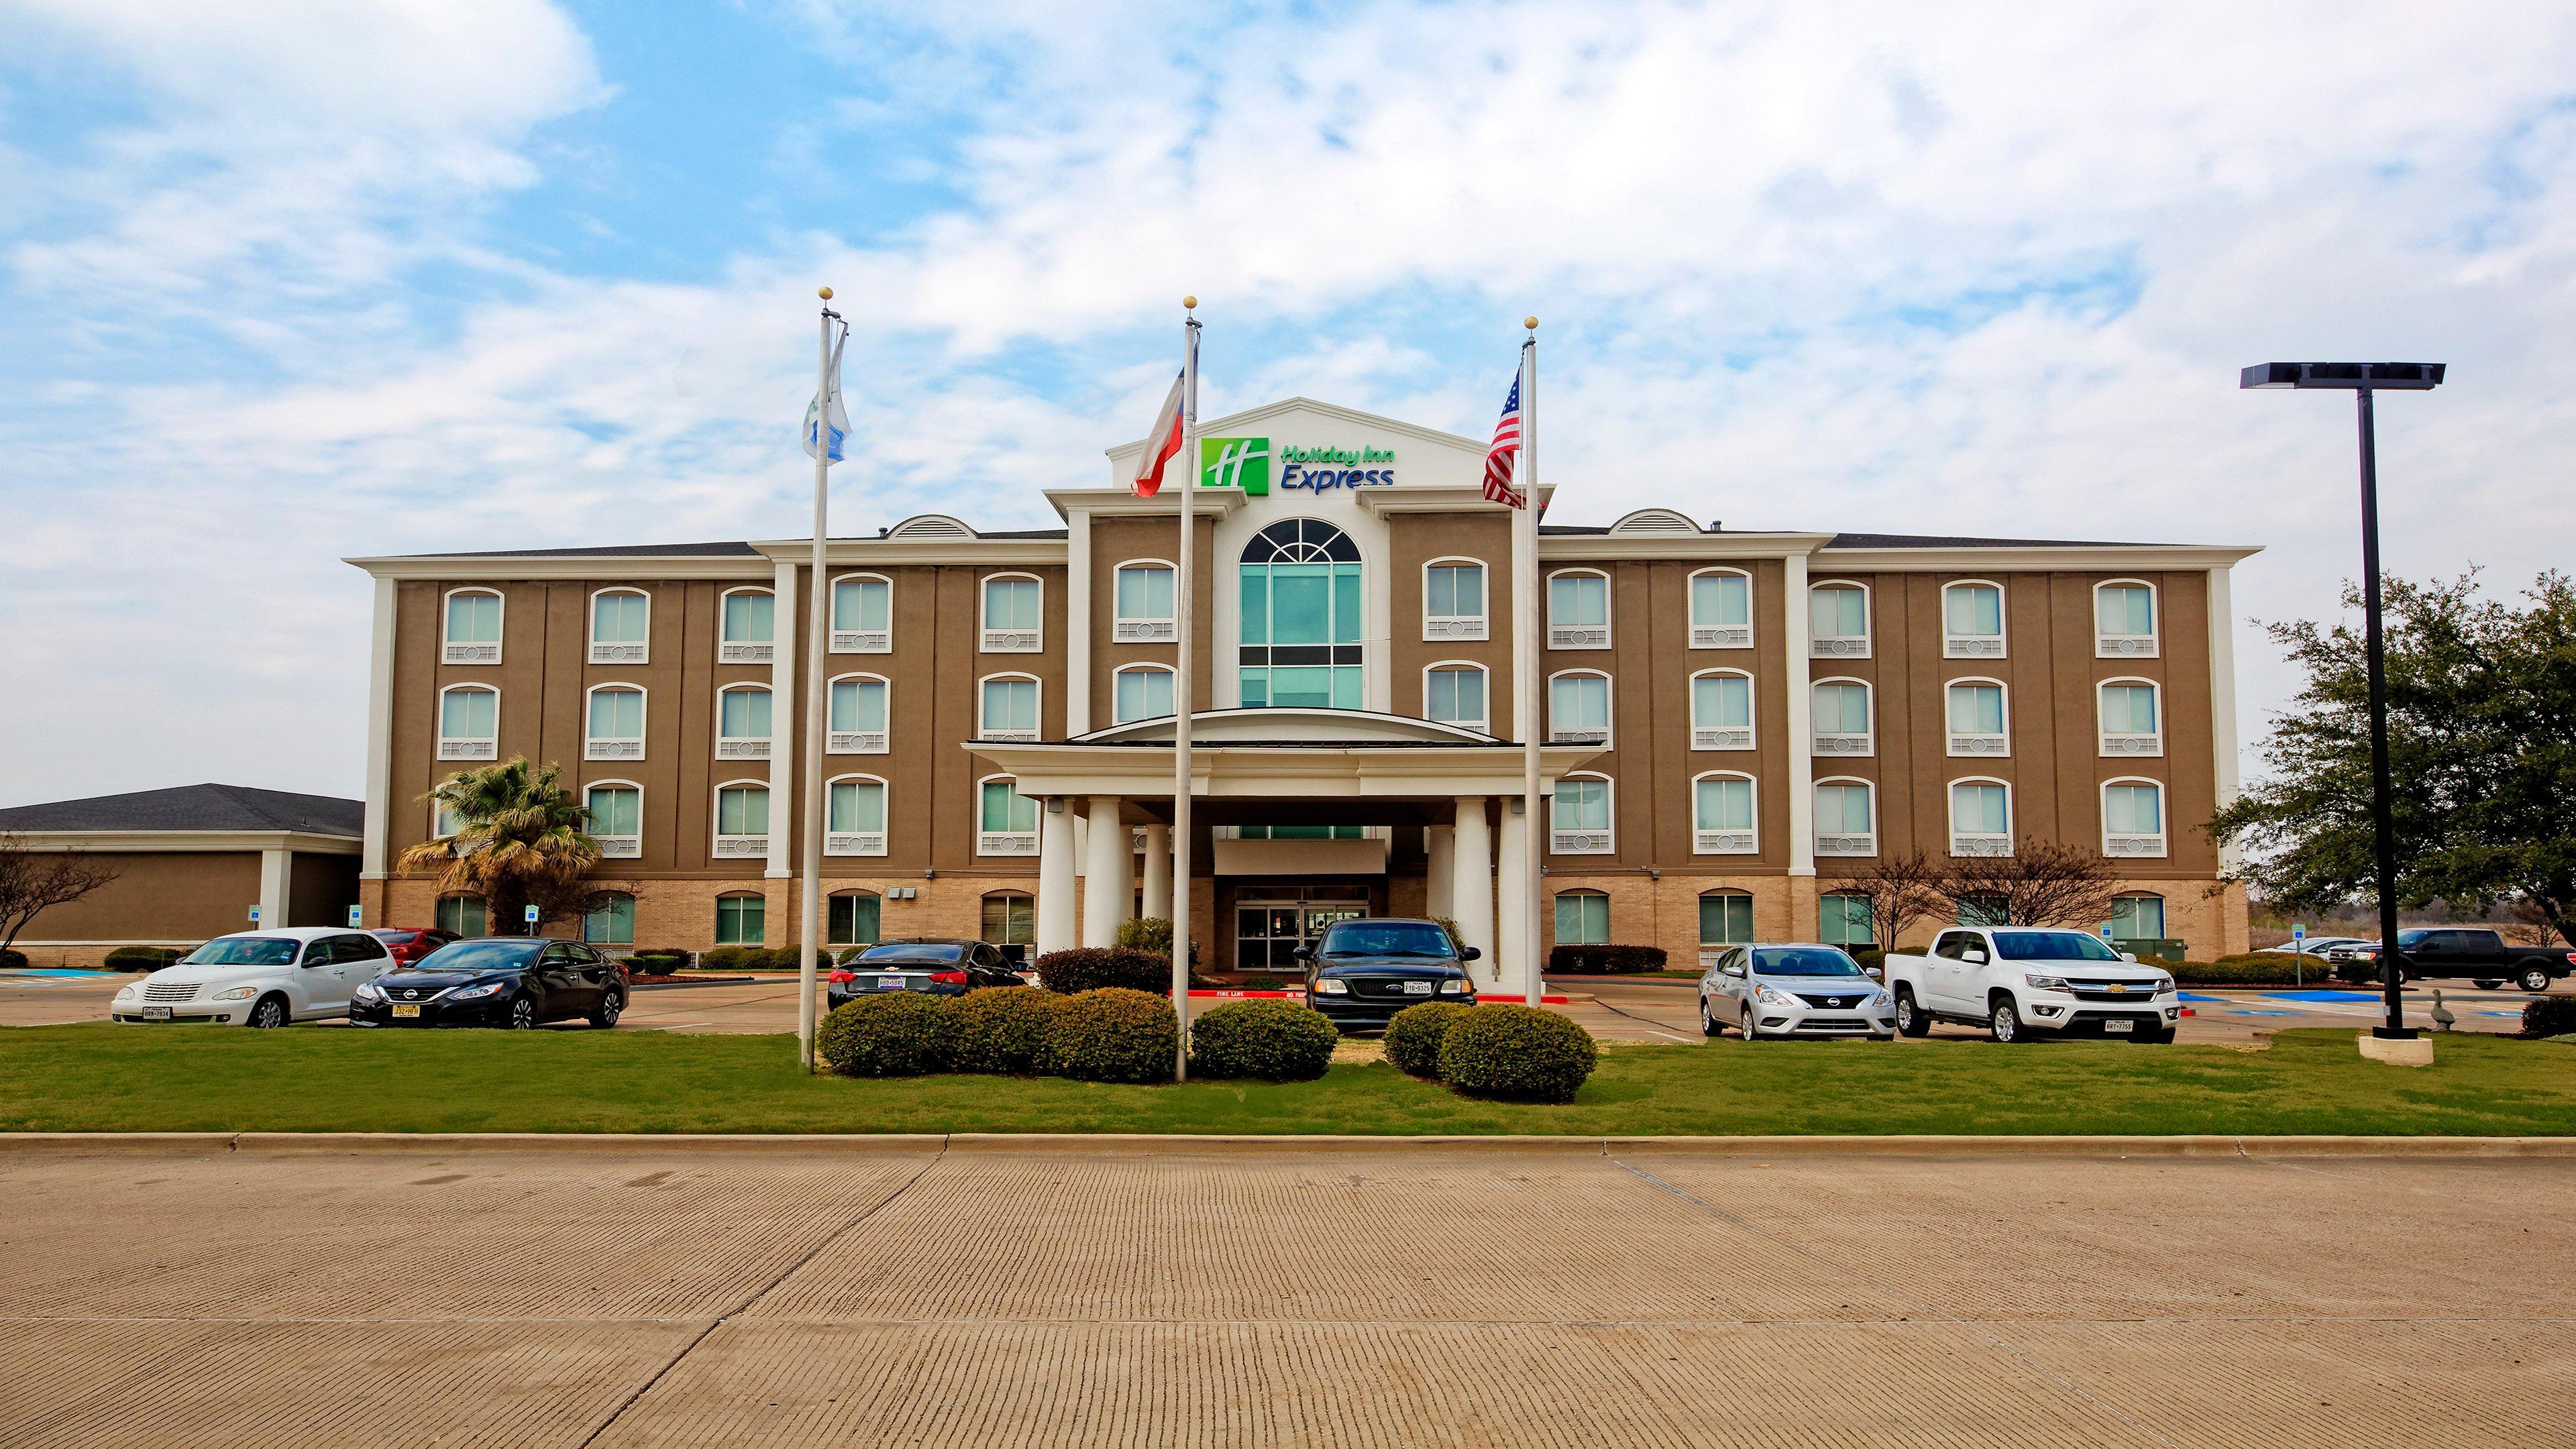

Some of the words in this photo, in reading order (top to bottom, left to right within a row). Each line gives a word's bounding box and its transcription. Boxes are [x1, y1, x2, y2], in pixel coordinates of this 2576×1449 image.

[1281, 445, 1359, 466] Holiday
[1362, 444, 1395, 462] Inn
[1281, 464, 1395, 495] Express
